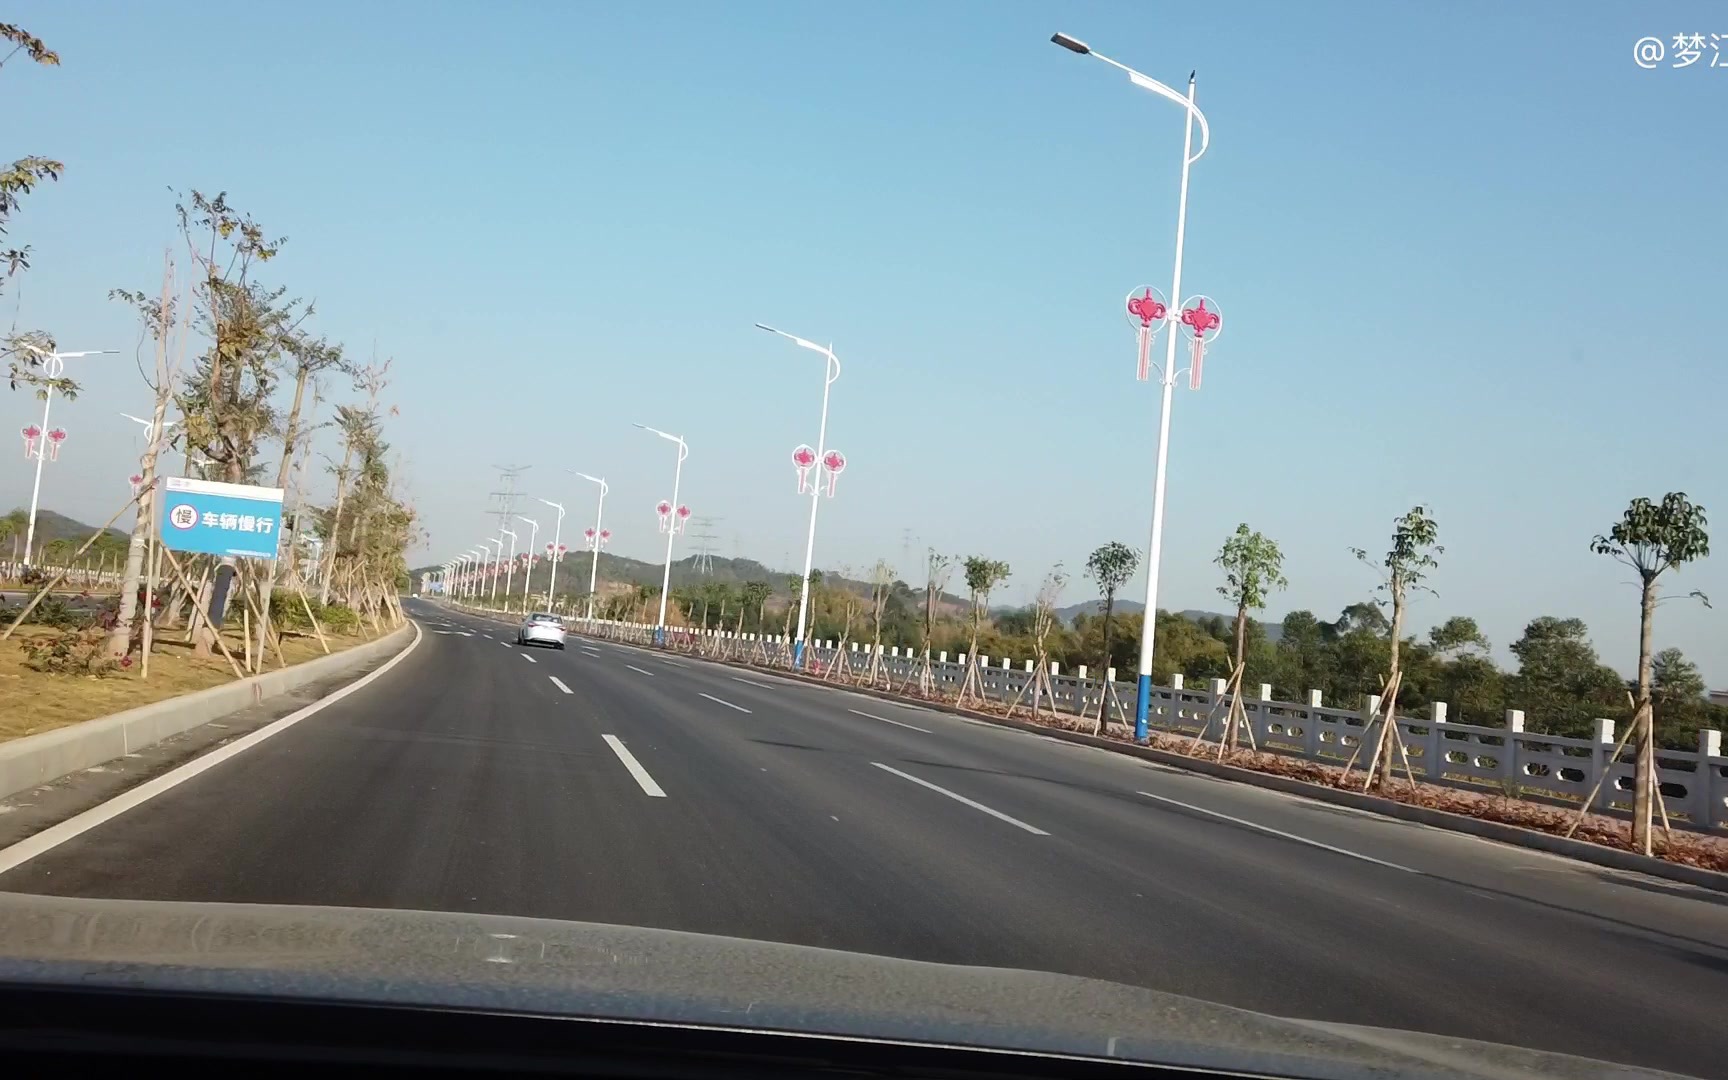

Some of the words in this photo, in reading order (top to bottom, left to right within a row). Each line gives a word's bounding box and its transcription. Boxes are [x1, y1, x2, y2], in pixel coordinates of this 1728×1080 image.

[176, 508, 192, 525] 慢
[201, 511, 274, 534] 车辆慢行
